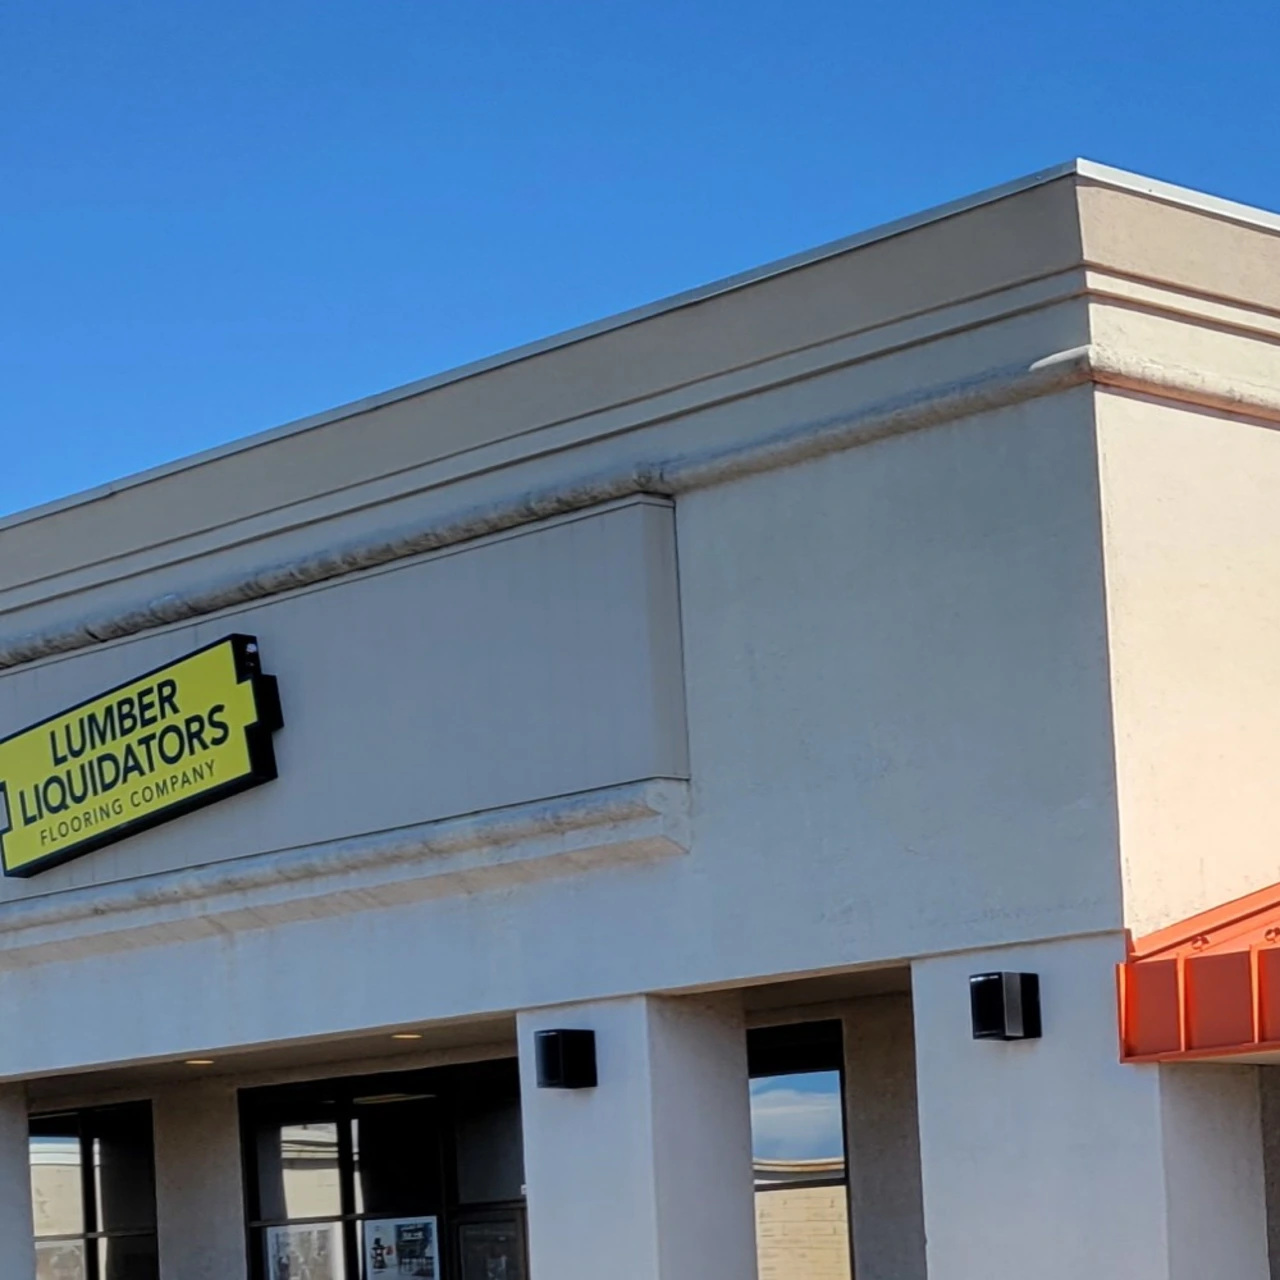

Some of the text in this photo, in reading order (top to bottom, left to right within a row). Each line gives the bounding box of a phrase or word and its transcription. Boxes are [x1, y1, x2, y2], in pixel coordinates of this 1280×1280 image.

[19, 704, 231, 826] LIQUIDATORS
[49, 678, 181, 768] LUMBER
[40, 759, 217, 847] FLOORING COMPANY
